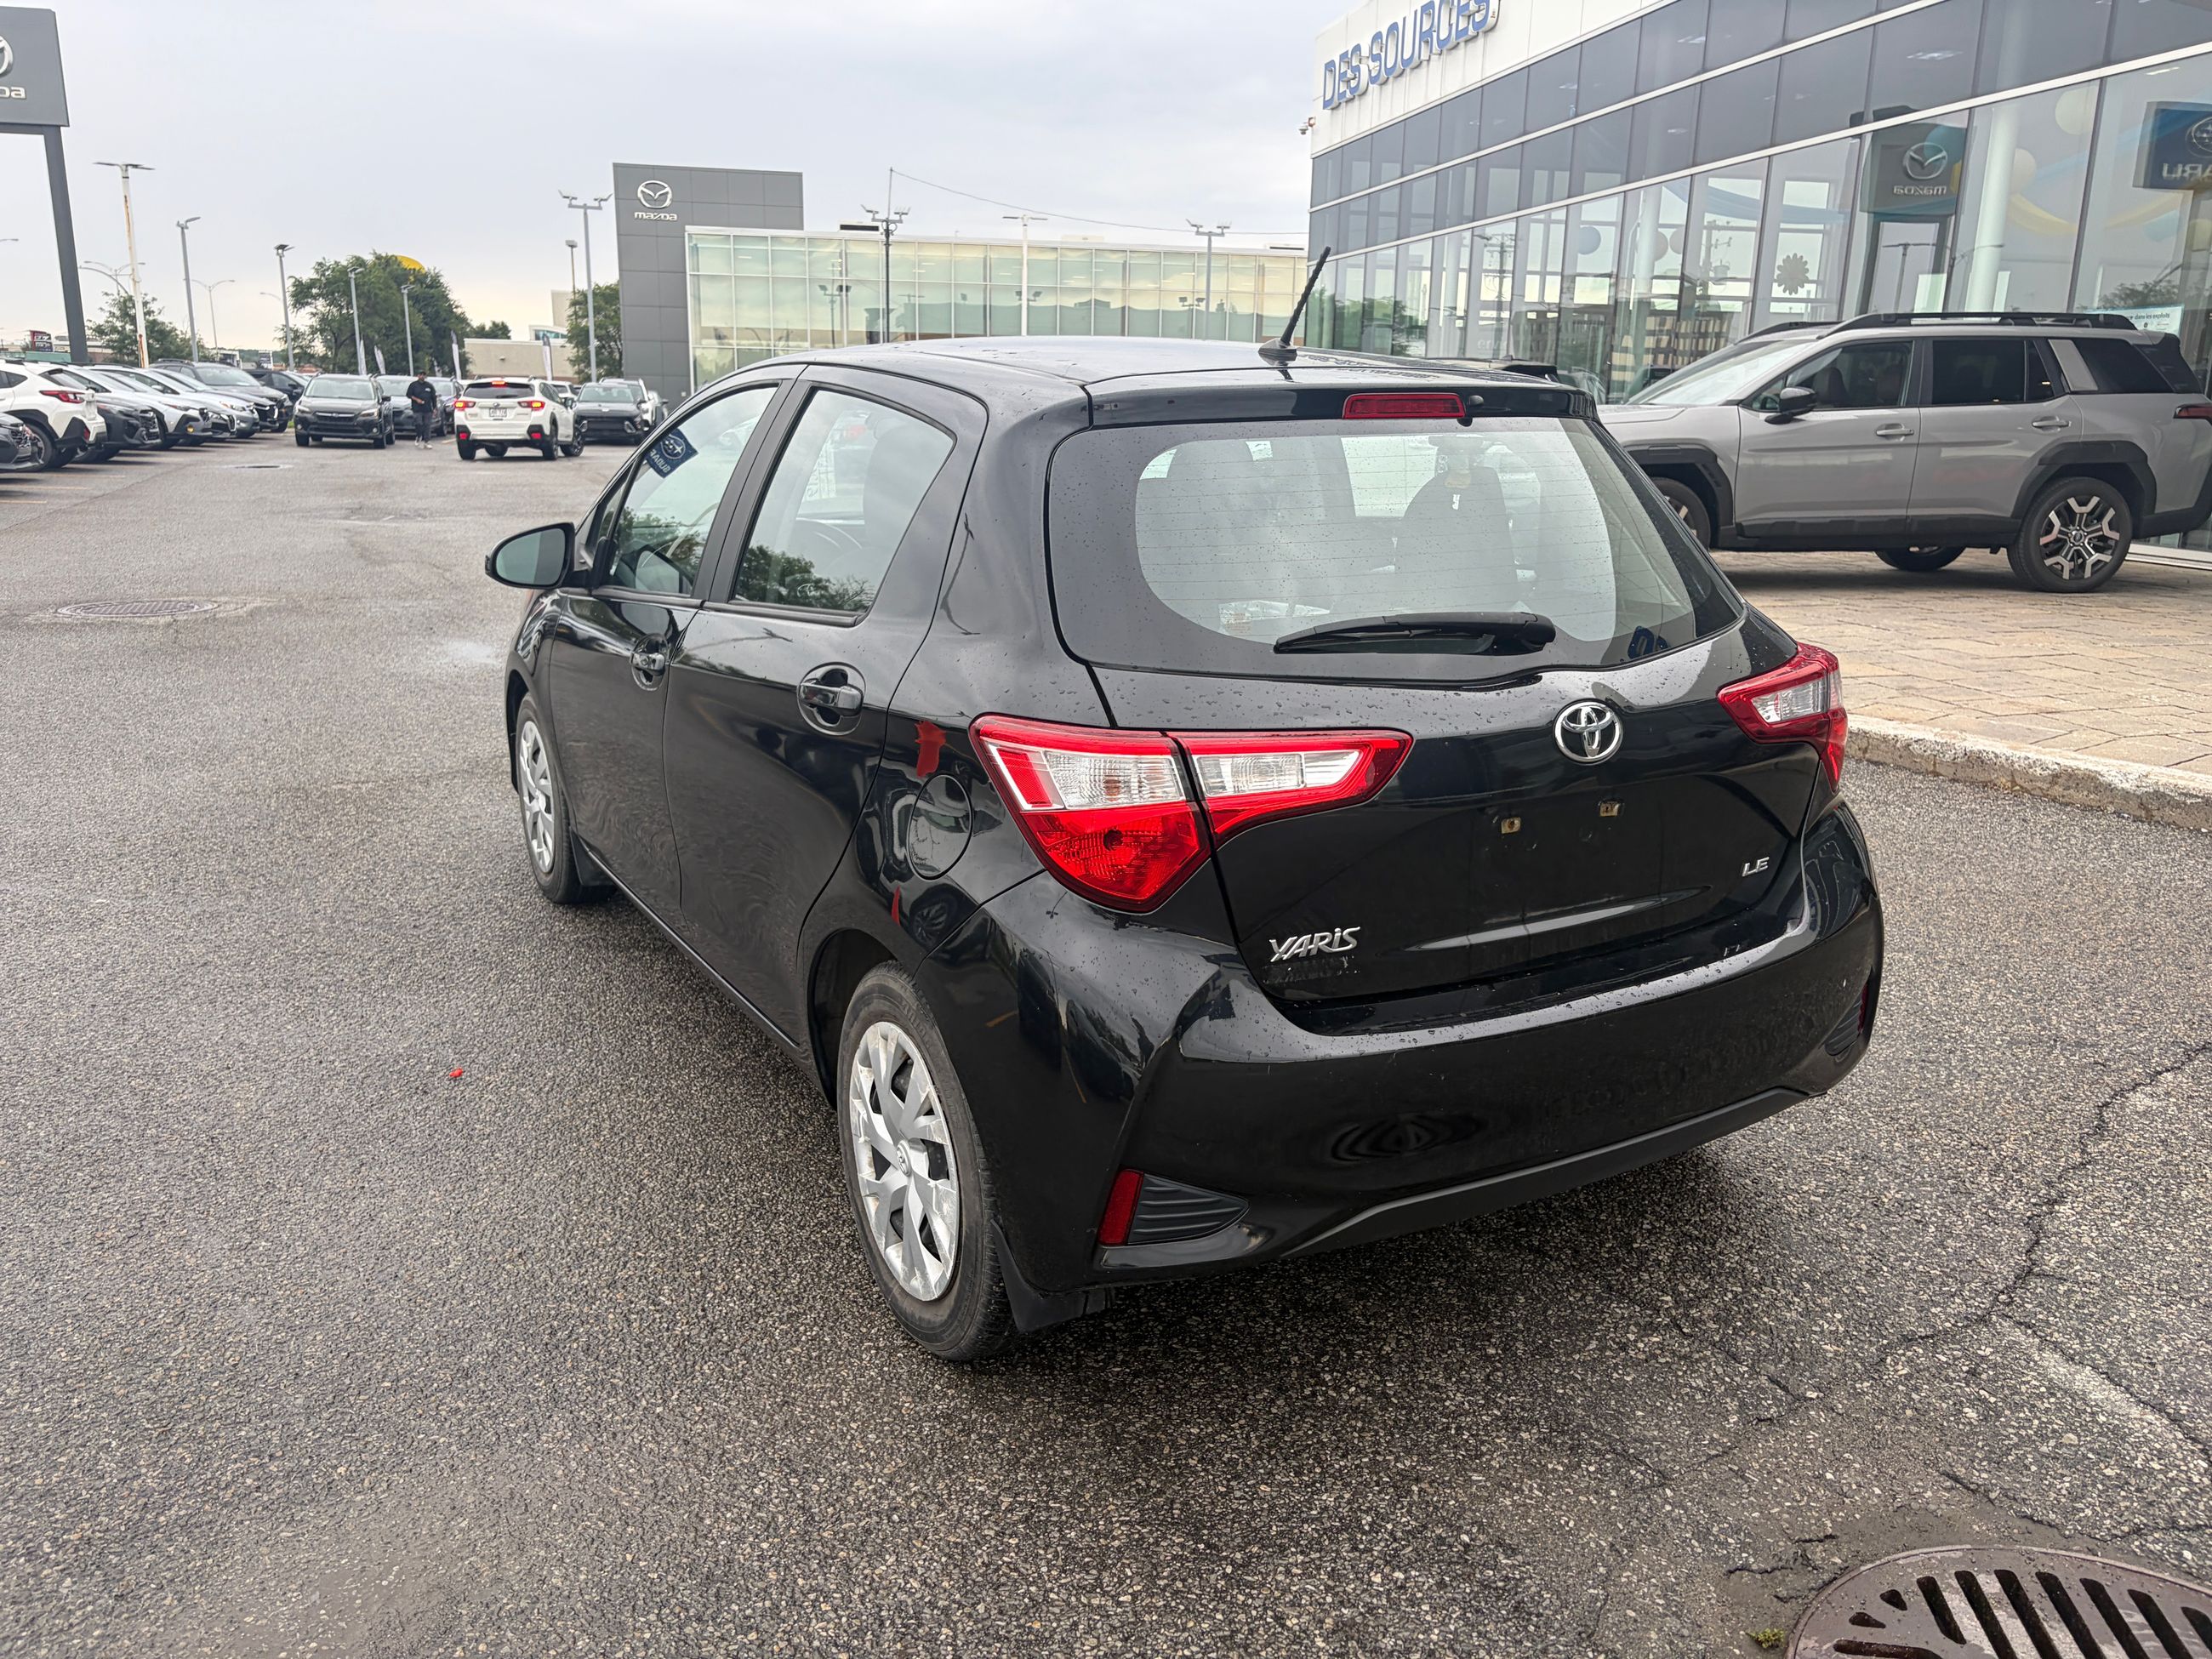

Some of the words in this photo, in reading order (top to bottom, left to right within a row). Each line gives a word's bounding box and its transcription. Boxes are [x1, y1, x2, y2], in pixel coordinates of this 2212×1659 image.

[1323, 43, 1362, 110] DES
[1369, 0, 1491, 85] SOURCES
[634, 211, 678, 221] mazda
[1742, 856, 1770, 877] LE
